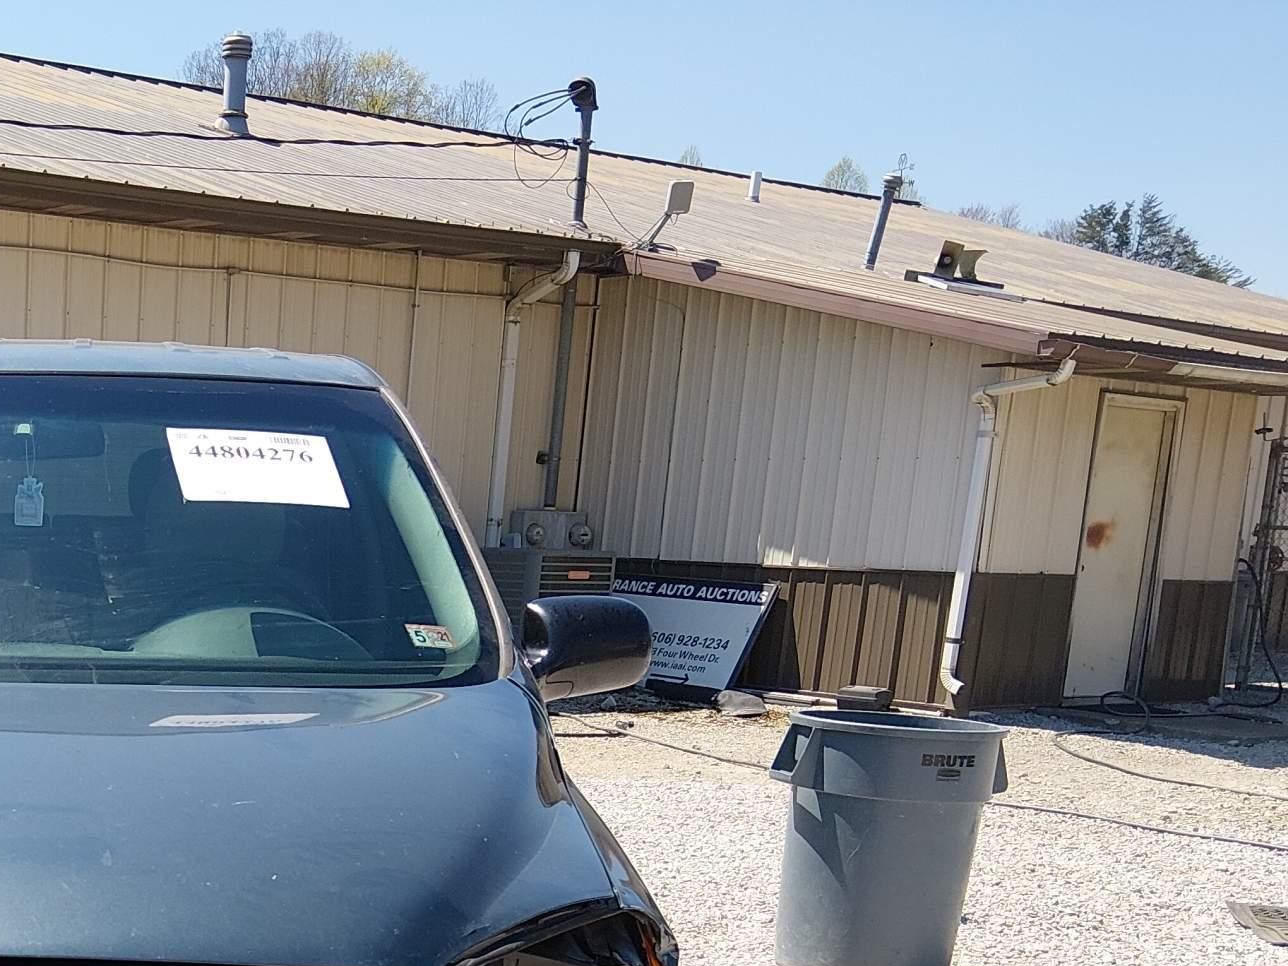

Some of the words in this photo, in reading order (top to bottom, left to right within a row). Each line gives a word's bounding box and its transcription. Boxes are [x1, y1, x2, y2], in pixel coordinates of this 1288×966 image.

[189, 445, 313, 463] 44804276
[656, 583, 695, 597] AUTO
[696, 588, 769, 603] AUCTIONS
[414, 630, 427, 643] 5
[676, 635, 730, 650] 928-1234
[657, 648, 679, 658] Four
[678, 650, 708, 662] Wheel
[707, 653, 720, 664] Dr.
[921, 753, 975, 767] BRUTE
